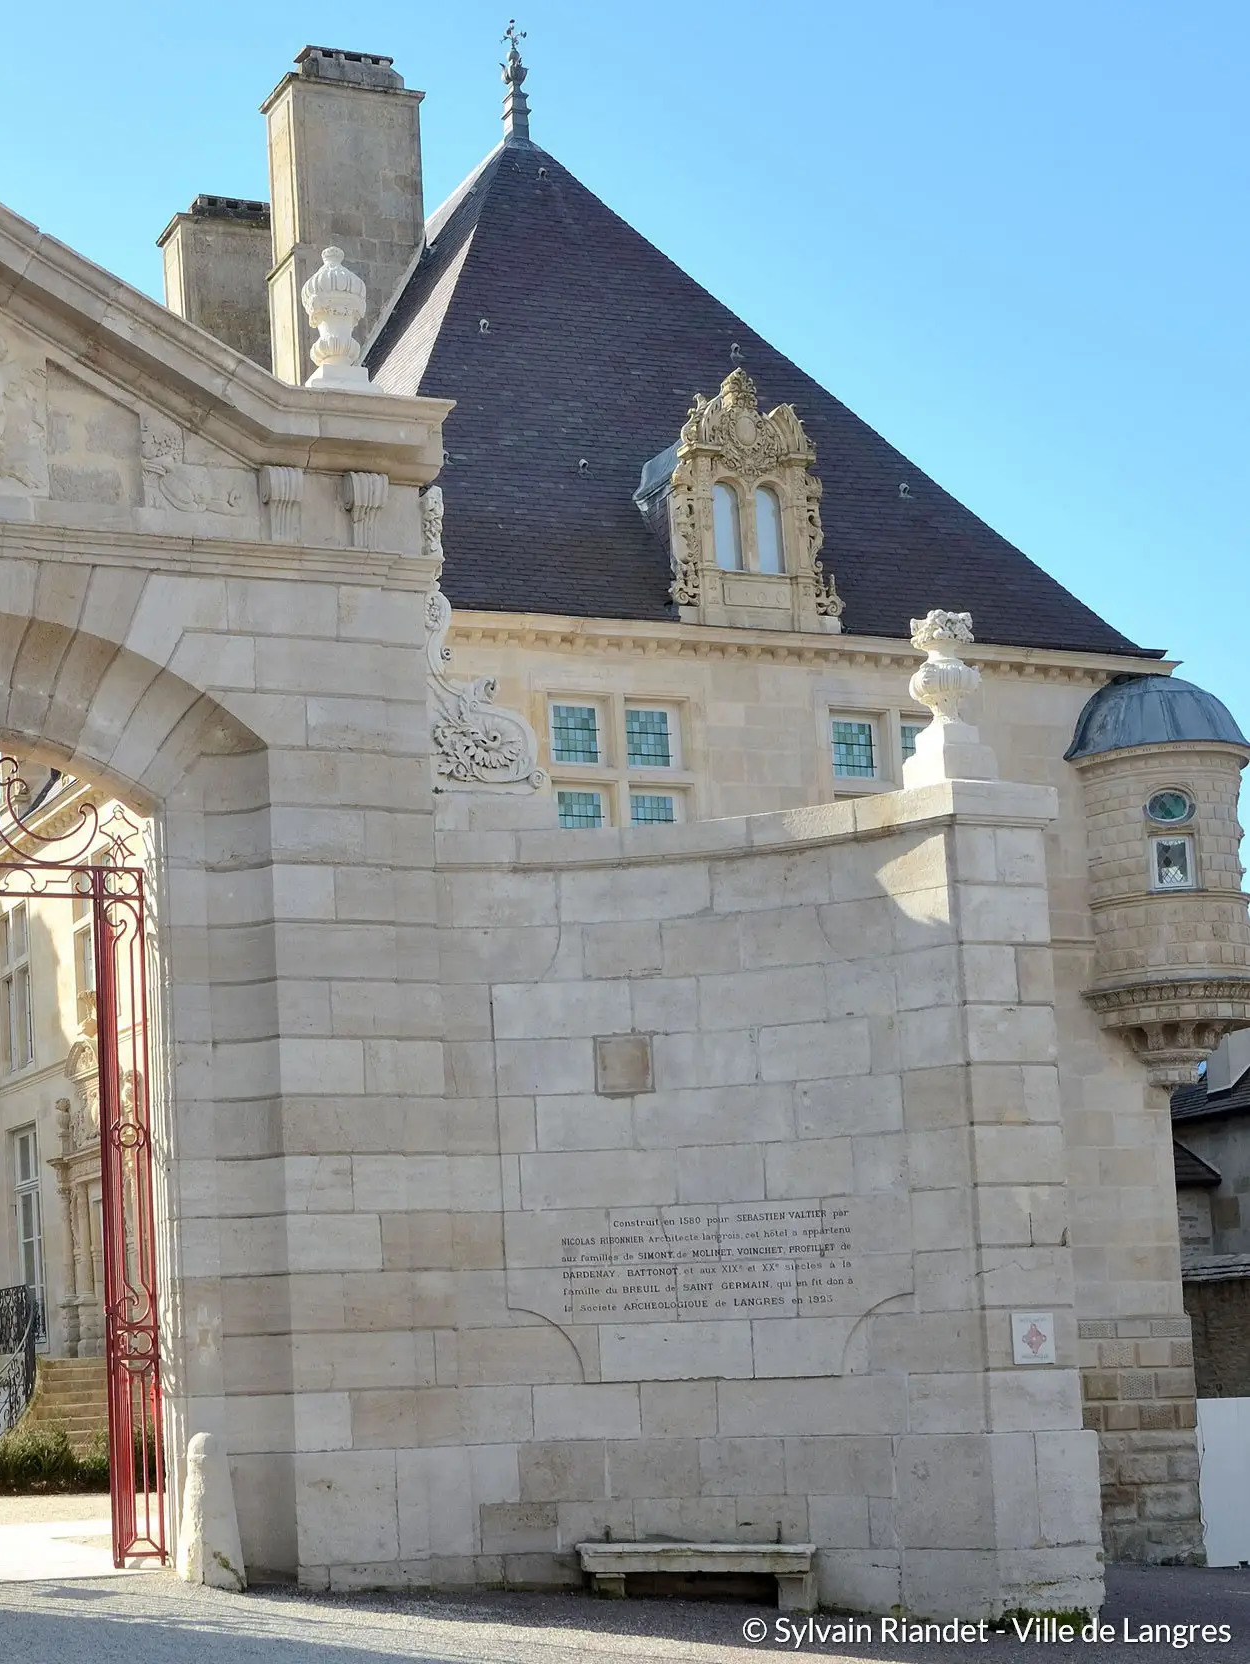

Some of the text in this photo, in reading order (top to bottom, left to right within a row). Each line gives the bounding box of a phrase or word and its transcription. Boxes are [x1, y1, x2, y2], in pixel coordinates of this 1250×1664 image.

[614, 1218, 659, 1227] Construit
[680, 1217, 701, 1225] 1580
[707, 1216, 729, 1226] pour
[788, 1210, 826, 1219] VALTIER
[833, 1210, 849, 1219] par
[562, 1238, 596, 1246] NICOLAS
[600, 1236, 644, 1245] RIBONNIER
[649, 1233, 698, 1243] Architecte
[745, 1231, 759, 1239] cet
[802, 1227, 850, 1238] appartenu
[581, 1253, 619, 1262] familles
[843, 1260, 851, 1268] la
[563, 1286, 600, 1296] famille
[606, 1286, 617, 1294] du
[623, 1285, 660, 1294] BREUIL
[683, 1283, 714, 1291] SAINT
[776, 1280, 792, 1290] qui
[812, 1278, 822, 1286] fit
[827, 1276, 844, 1286] don
[564, 1304, 573, 1312] la
[734, 1297, 785, 1307] LANGRES
